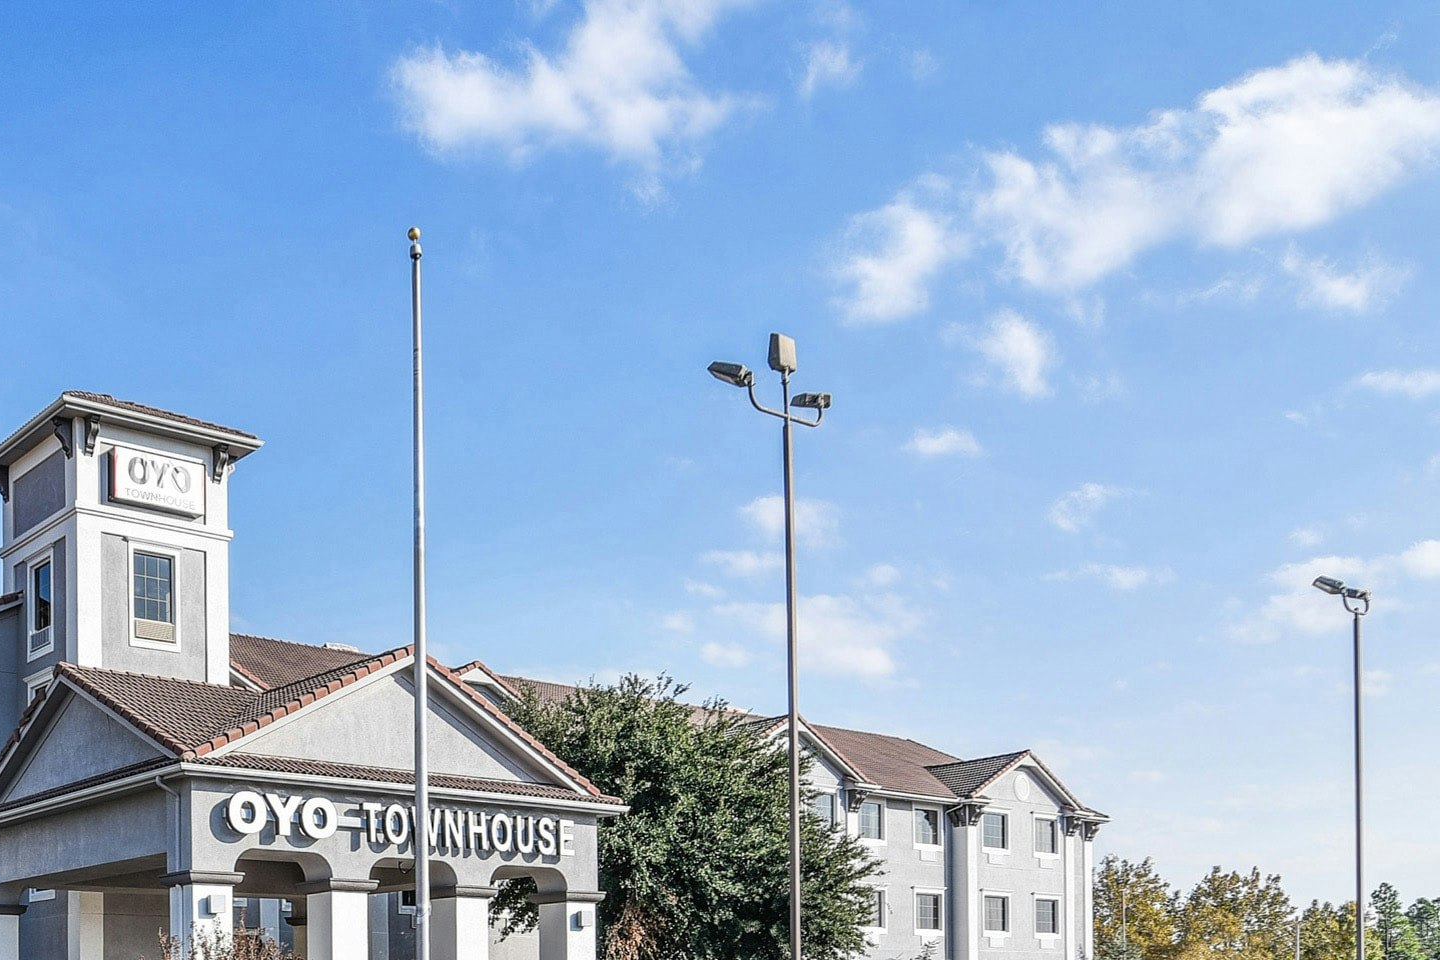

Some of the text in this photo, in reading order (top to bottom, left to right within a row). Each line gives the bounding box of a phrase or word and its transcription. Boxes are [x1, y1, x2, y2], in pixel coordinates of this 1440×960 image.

[128, 456, 191, 494] OYO
[125, 487, 196, 511] TOWNHOUSE
[227, 790, 338, 839] OYO
